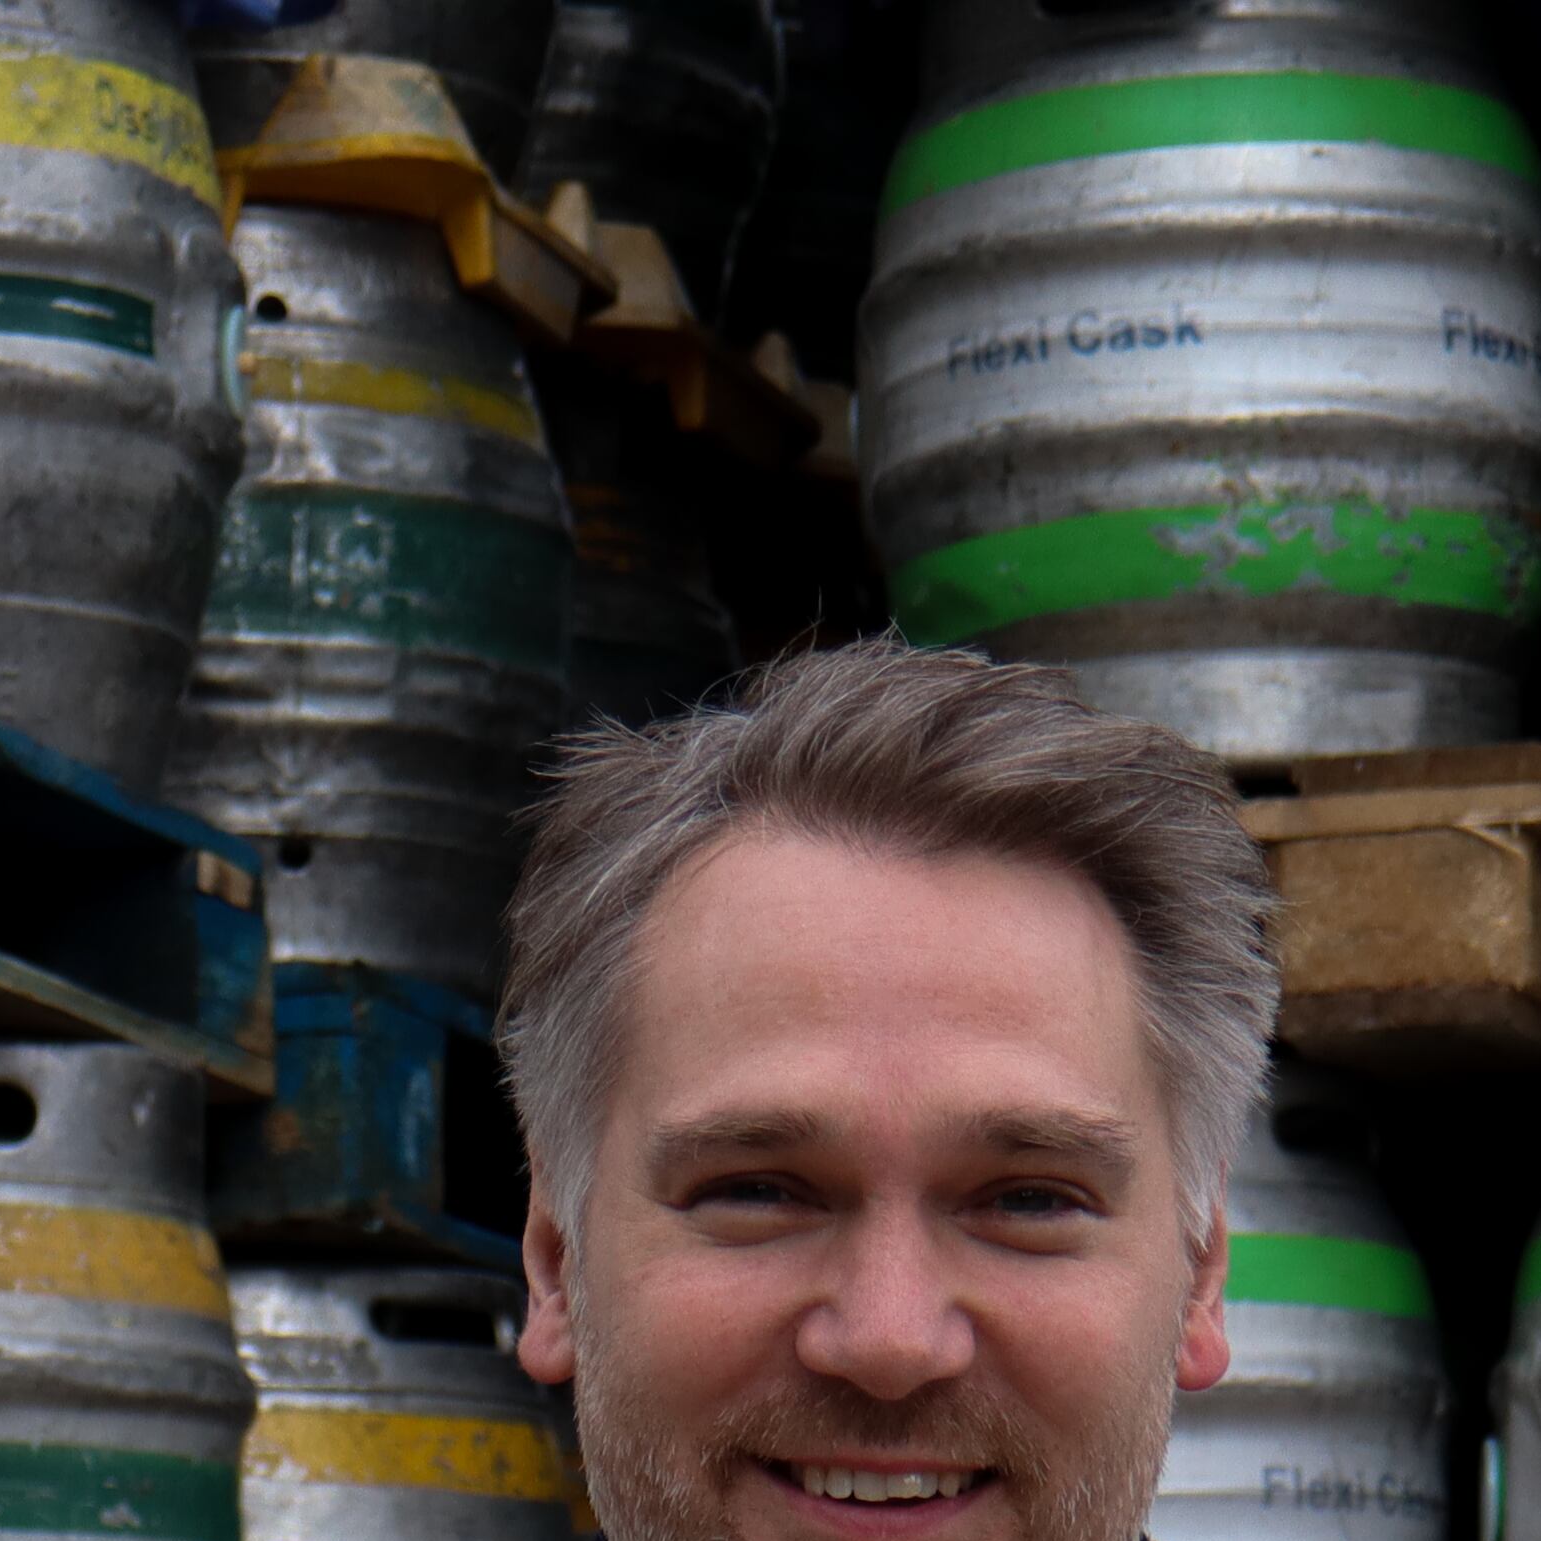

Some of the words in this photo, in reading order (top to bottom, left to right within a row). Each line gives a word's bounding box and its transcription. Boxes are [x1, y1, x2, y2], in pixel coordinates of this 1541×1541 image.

[947, 316, 1049, 382] Flexi
[1066, 299, 1205, 356] Cask
[1262, 1464, 1367, 1513] Flexi
